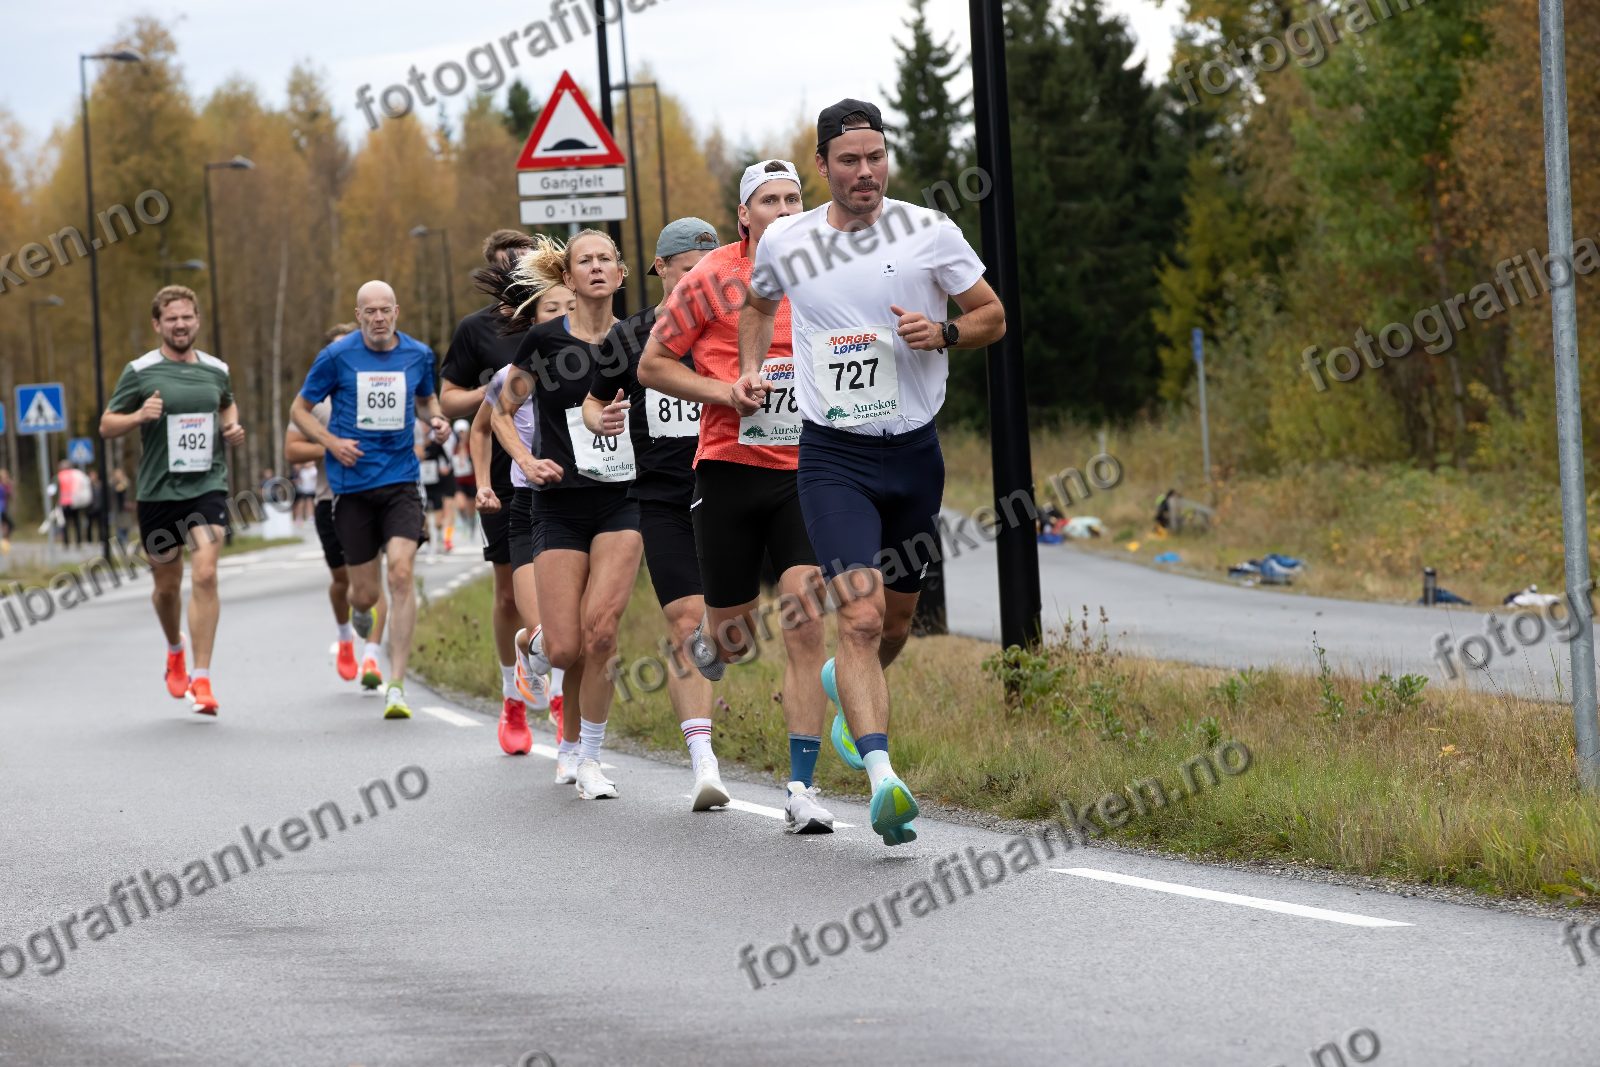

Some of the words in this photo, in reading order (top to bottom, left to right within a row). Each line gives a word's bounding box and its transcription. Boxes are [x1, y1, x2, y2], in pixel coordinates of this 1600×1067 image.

[540, 175, 604, 191] Gangfelt
[581, 205, 603, 216] km
[829, 333, 878, 346] NORGES
[833, 343, 871, 355] LØPET
[763, 363, 795, 373] NORG
[828, 357, 879, 391] 727
[367, 391, 396, 409] 636
[853, 399, 897, 414] Aurskog
[658, 397, 701, 423] 813
[178, 433, 206, 450] 492
[592, 434, 618, 452] 40
